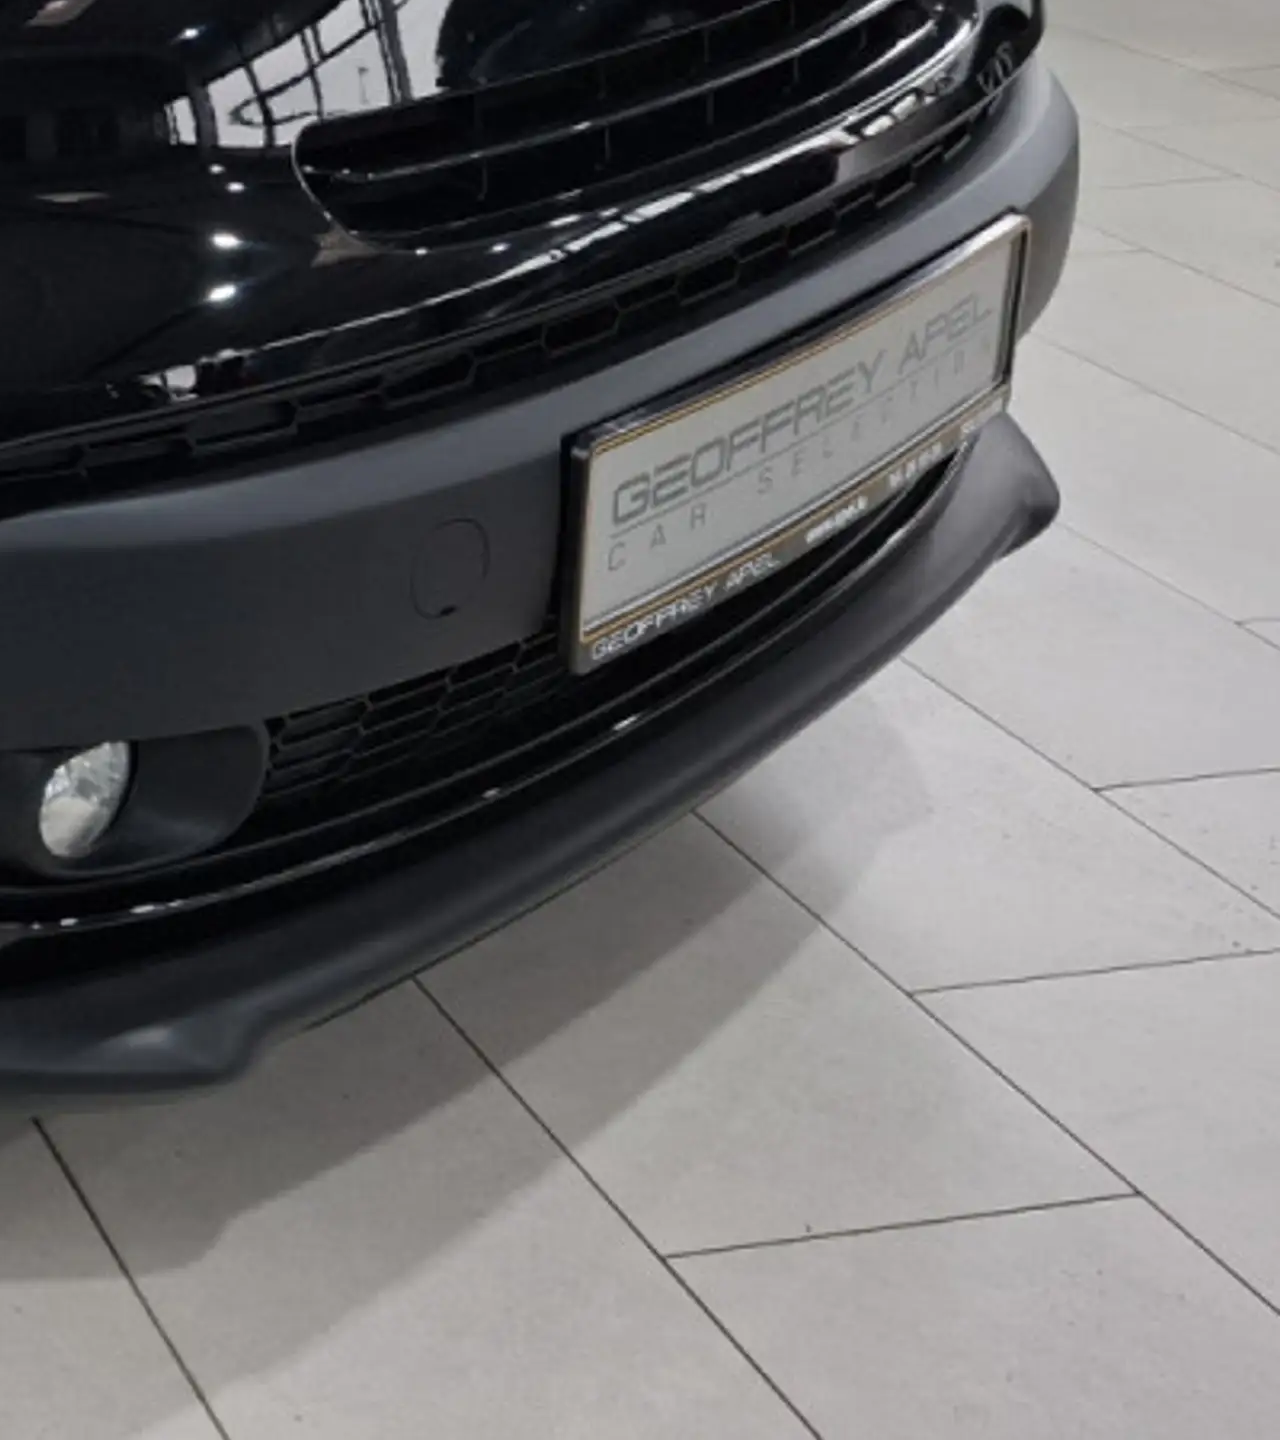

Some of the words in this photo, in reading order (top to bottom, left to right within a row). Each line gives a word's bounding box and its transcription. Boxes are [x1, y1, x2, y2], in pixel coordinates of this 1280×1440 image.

[612, 349, 886, 526] GEOFFREY
[897, 293, 995, 375] APEL
[606, 503, 708, 572] CAR
[591, 584, 717, 660] GEOFFREY
[724, 553, 783, 591] APEL
